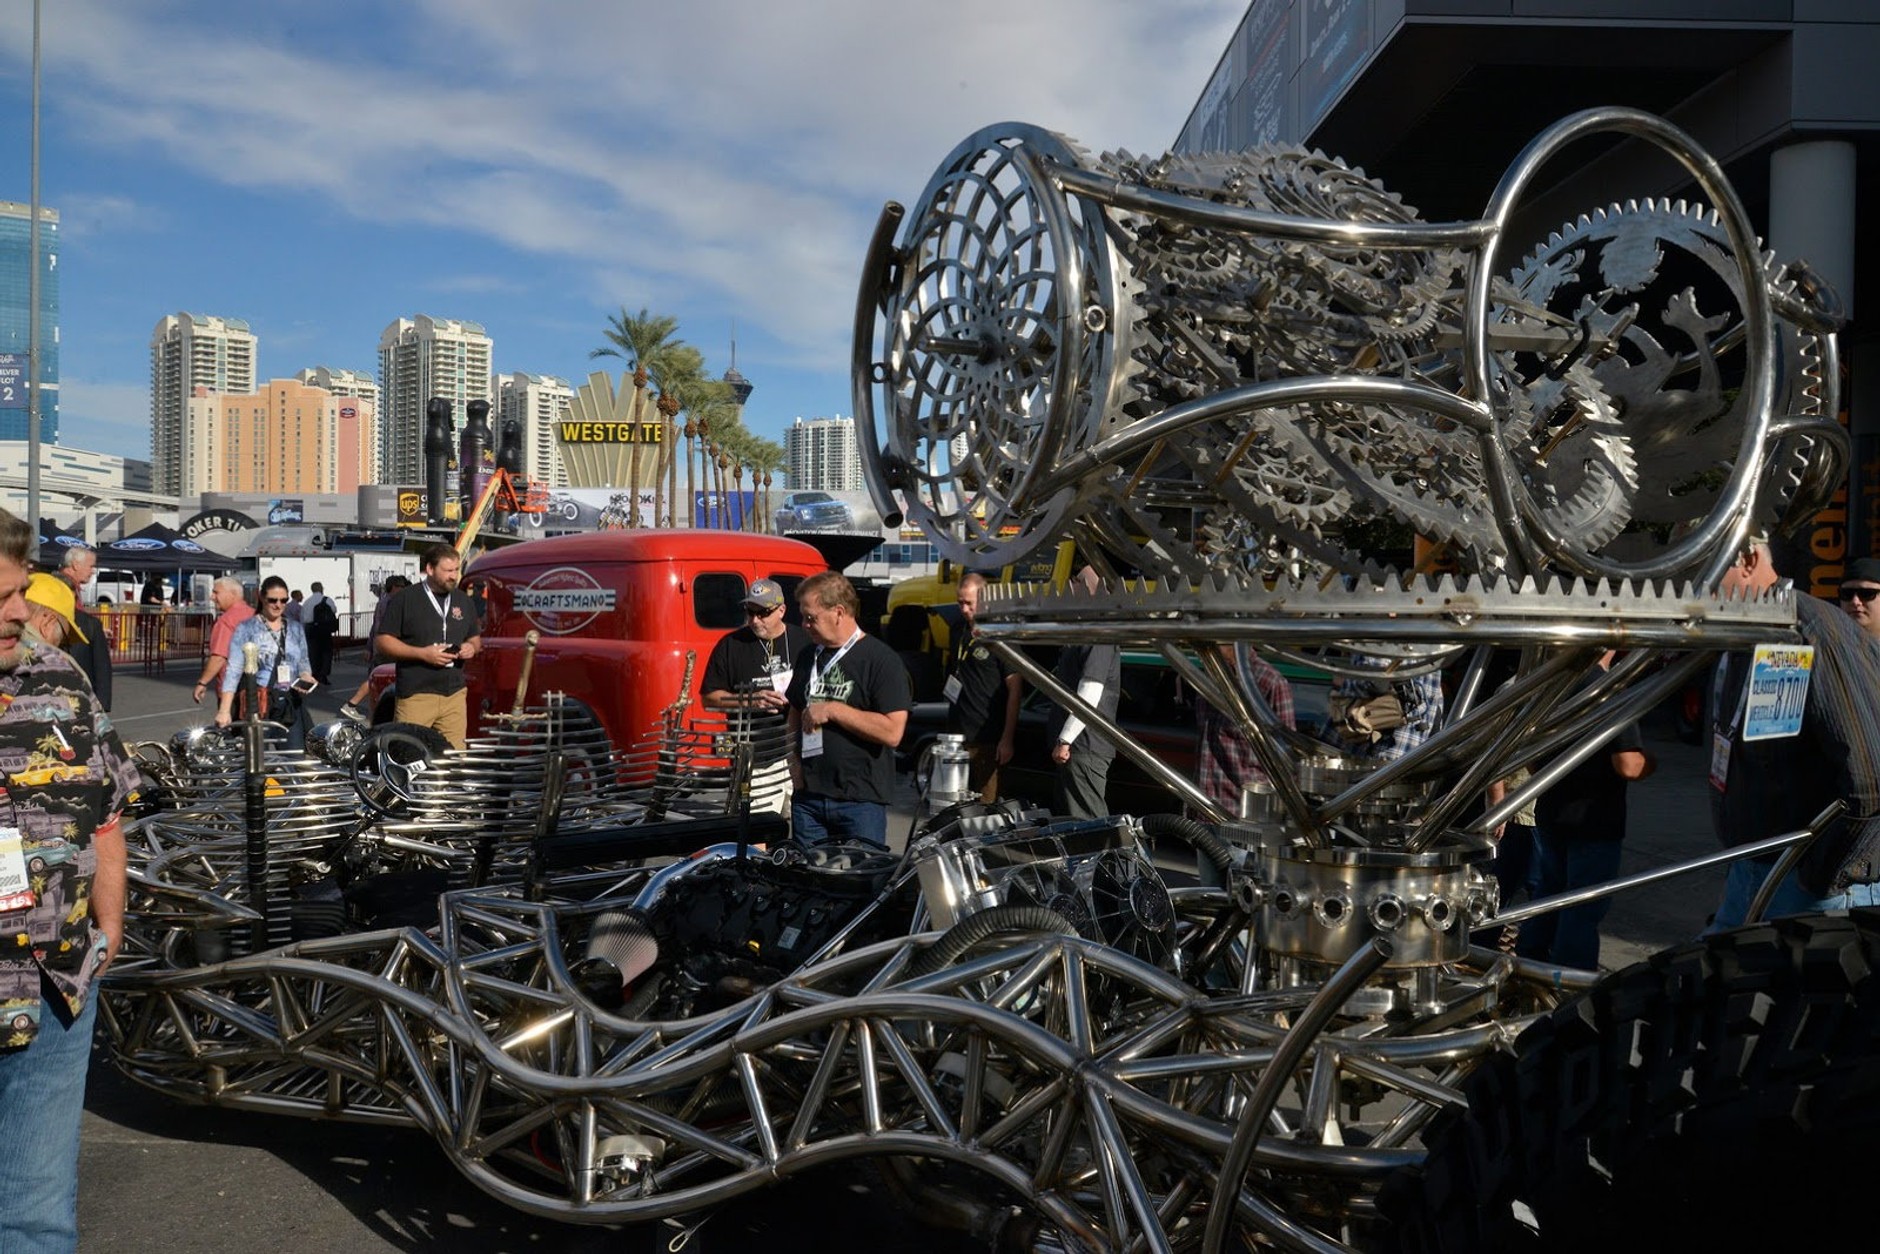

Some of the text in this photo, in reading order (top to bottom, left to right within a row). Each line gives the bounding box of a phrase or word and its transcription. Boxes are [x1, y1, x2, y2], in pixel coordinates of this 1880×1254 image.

[0, 368, 20, 376] ILVER
[3, 386, 14, 400] 2
[184, 516, 222, 538] OKER
[117, 540, 158, 551] Ford
[527, 594, 598, 608] CRAFTSMAN
[806, 683, 848, 697] UMMIT
